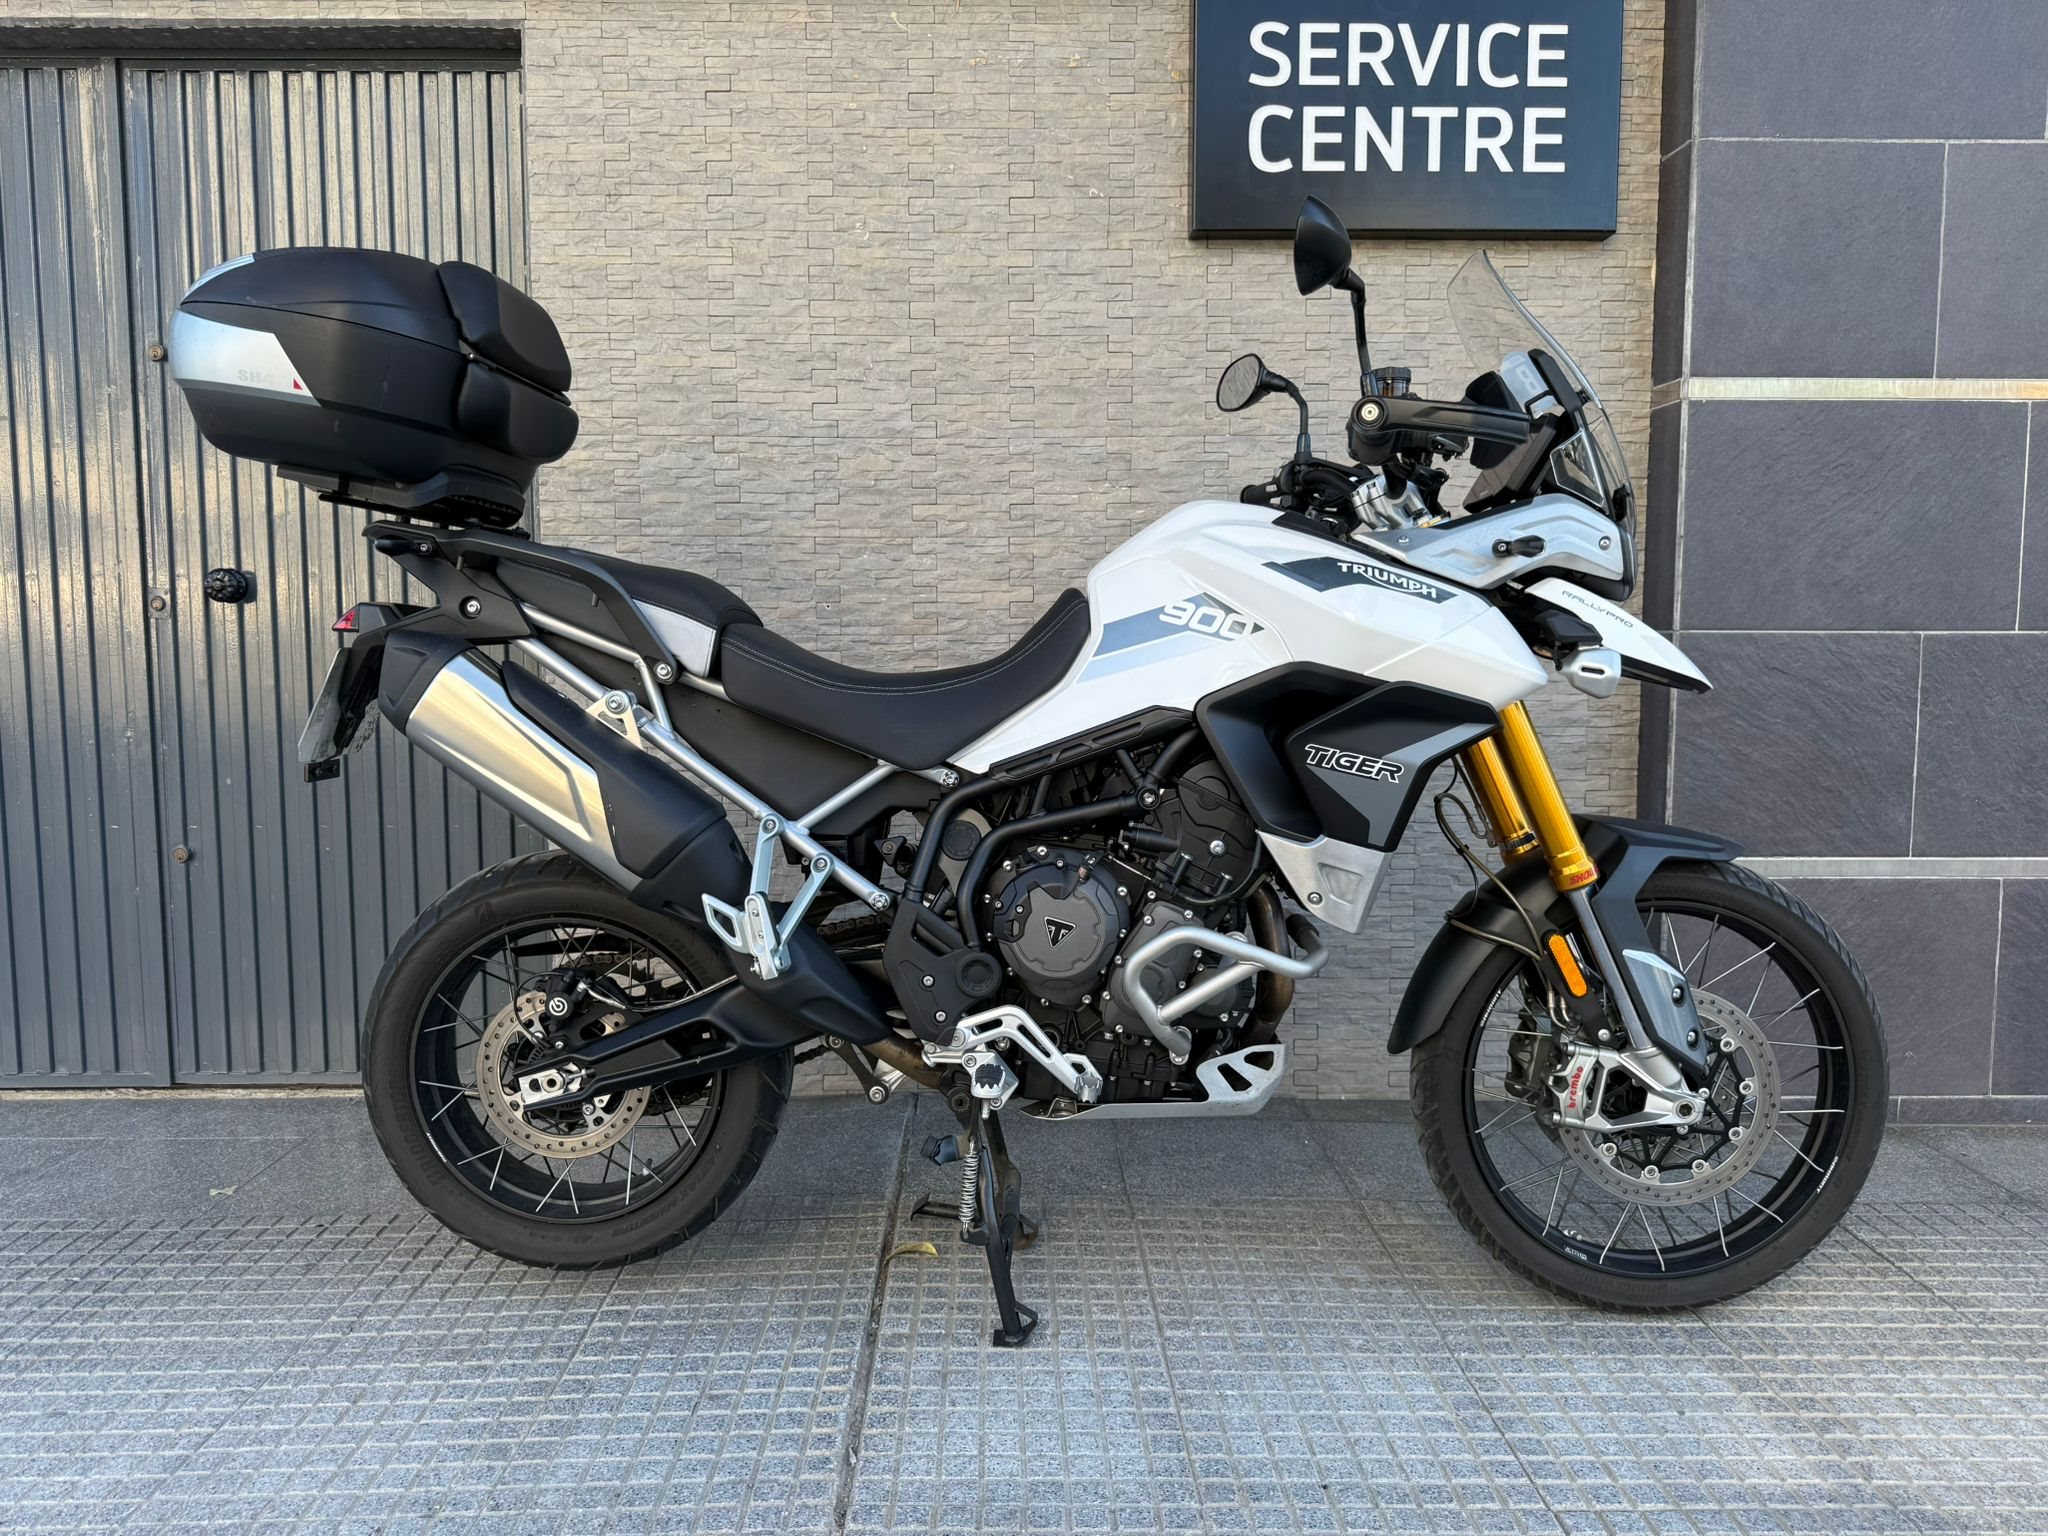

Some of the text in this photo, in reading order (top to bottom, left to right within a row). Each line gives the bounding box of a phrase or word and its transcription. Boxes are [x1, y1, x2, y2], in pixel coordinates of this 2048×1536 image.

[1248, 21, 1568, 88] SERVICE
[1248, 105, 1567, 173] CENTRE
[1337, 562, 1437, 599] TRIUMPH
[1159, 602, 1253, 640] 900
[1305, 743, 1404, 784] TIGER
[1567, 1065, 1584, 1109] brembo
